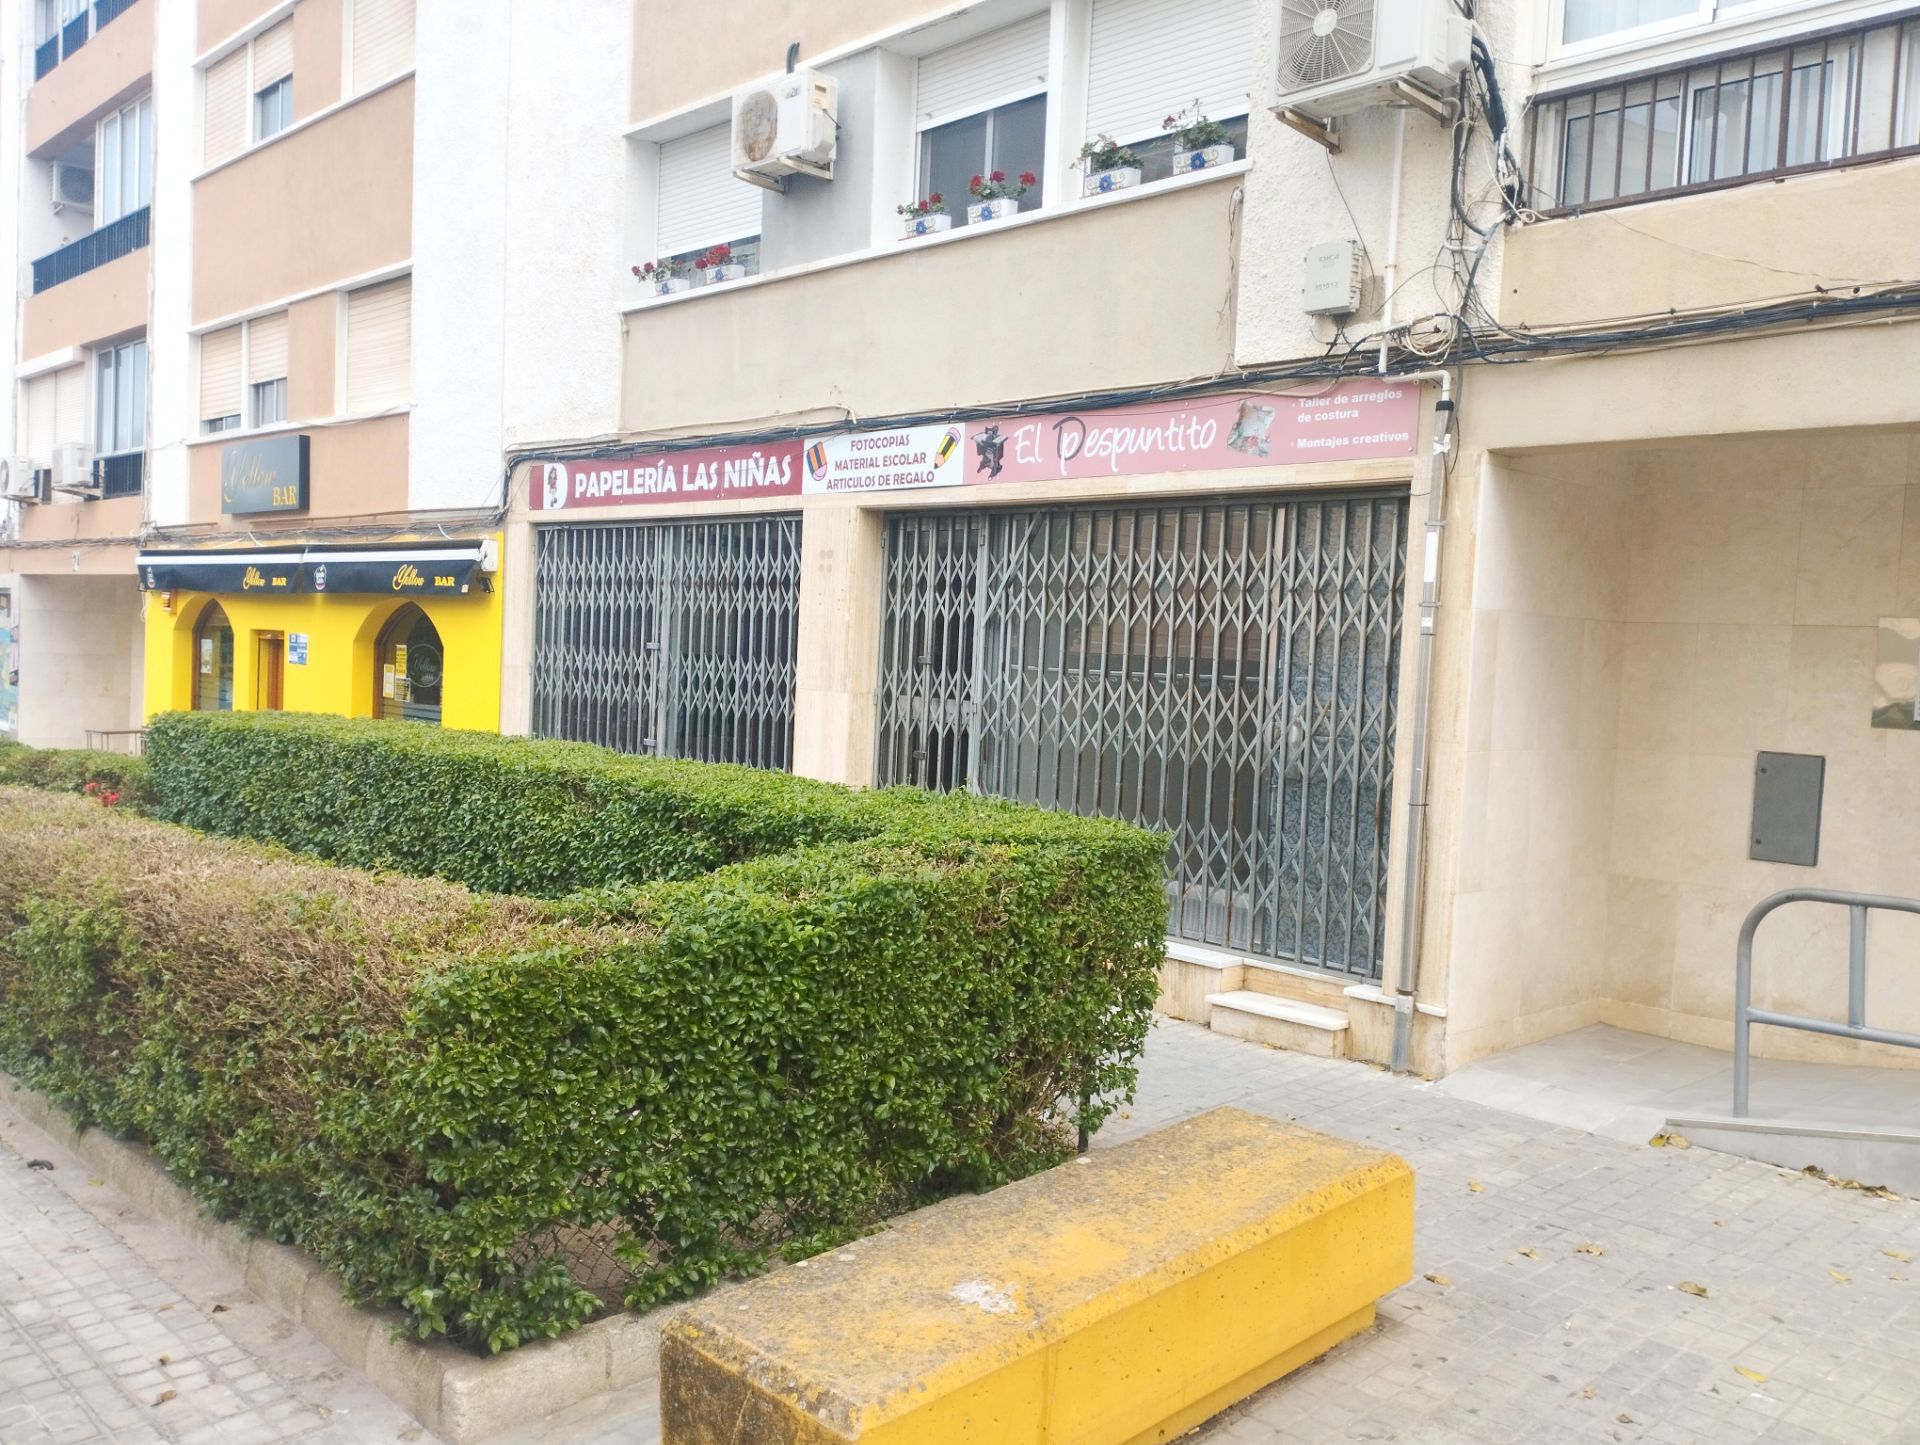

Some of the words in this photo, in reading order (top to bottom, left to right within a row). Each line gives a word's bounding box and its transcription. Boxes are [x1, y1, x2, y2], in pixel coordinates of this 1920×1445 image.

[1298, 396, 1331, 408] Taller
[1334, 394, 1348, 405] de
[1351, 389, 1403, 404] arreglos
[1297, 412, 1312, 423] de
[1314, 409, 1359, 421] costura
[851, 434, 910, 452] FOTOCOPIAS
[1014, 423, 1043, 464] El
[1297, 436, 1349, 449] Montajes
[1352, 431, 1409, 445] creativos
[834, 458, 880, 472] MATERIAL
[883, 452, 927, 468] ESCOLAR
[575, 459, 677, 499] PAPELERÍA
[682, 461, 718, 491] LAS
[724, 451, 792, 489] NIÑAS
[826, 474, 876, 491] ARTICULOS
[878, 474, 891, 487] DE
[893, 470, 935, 486] REGALO
[272, 485, 297, 506] BAR
[271, 576, 288, 587] BAR
[392, 564, 425, 591] Yellow
[434, 576, 455, 587] BAR
